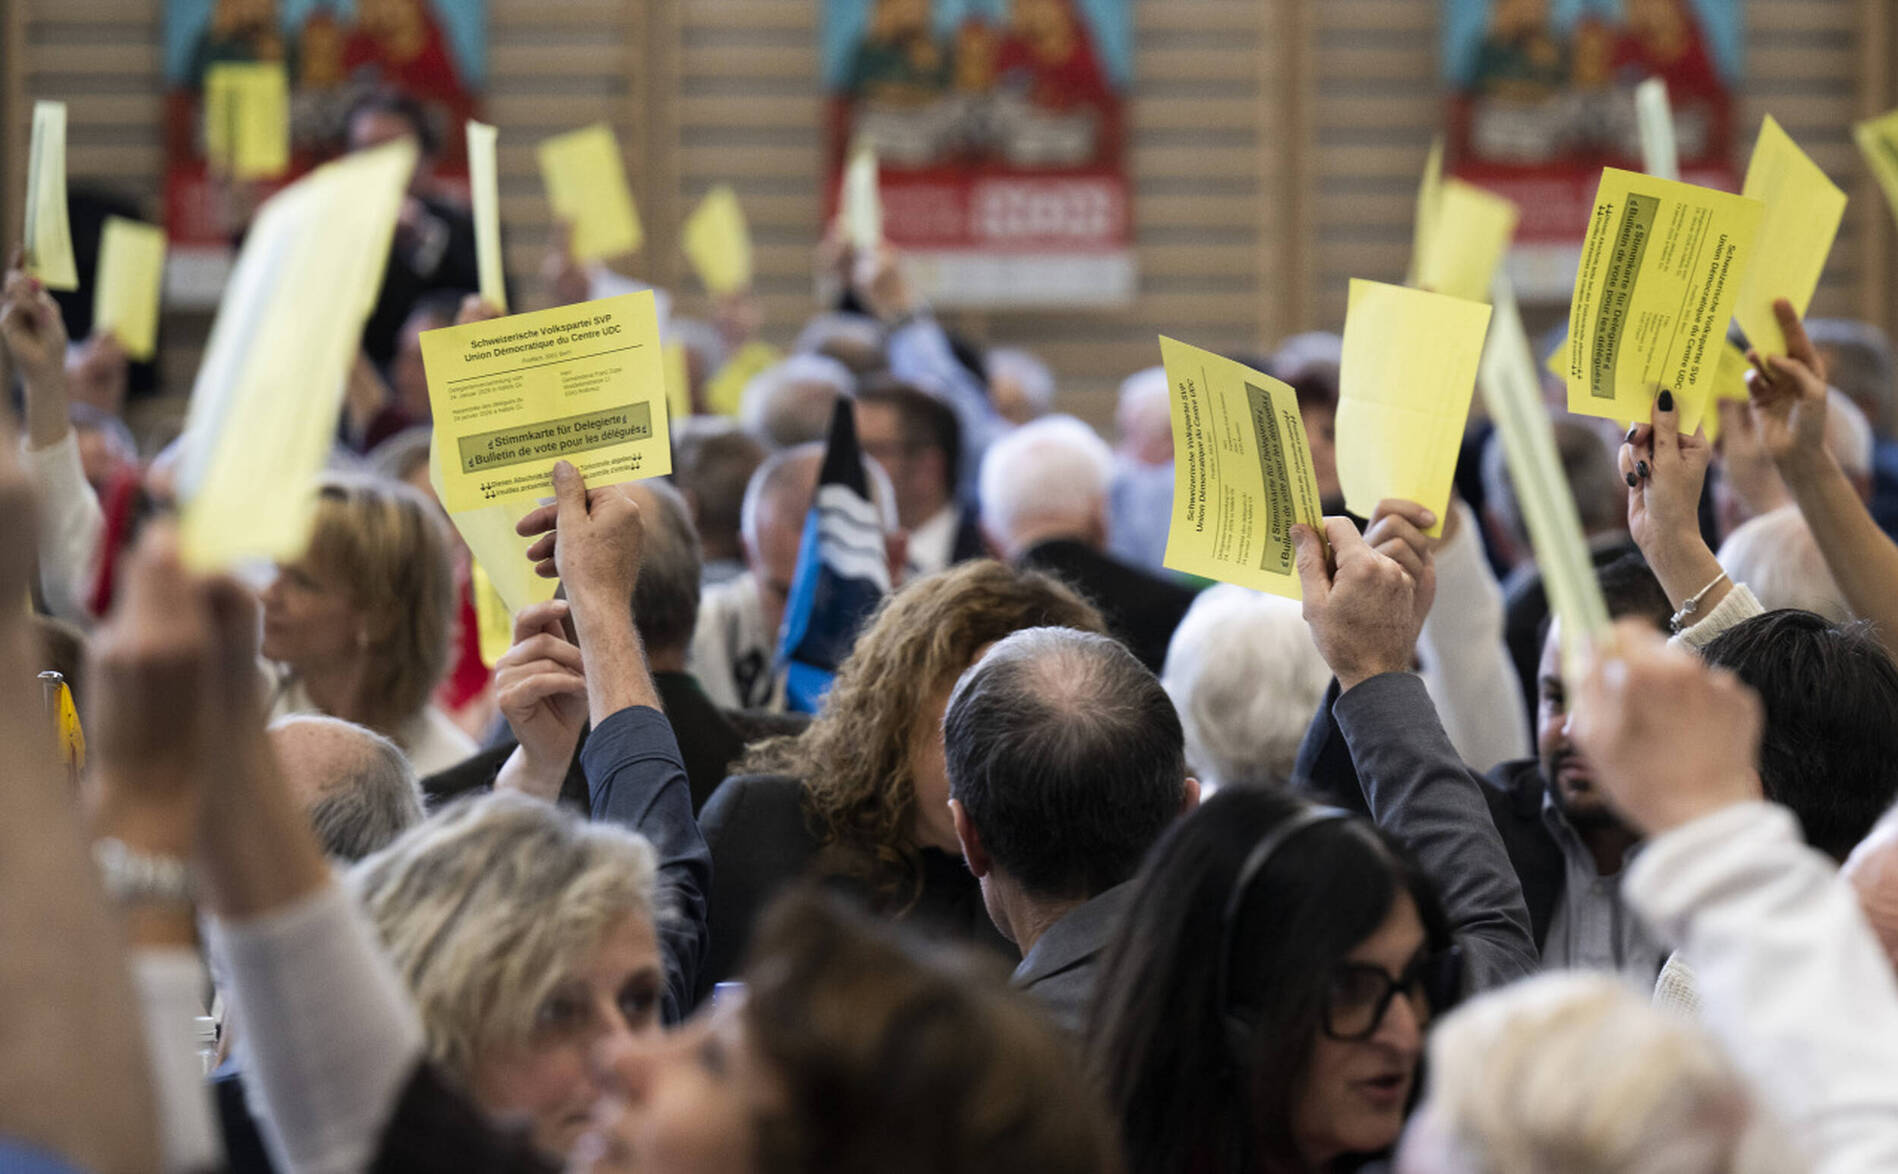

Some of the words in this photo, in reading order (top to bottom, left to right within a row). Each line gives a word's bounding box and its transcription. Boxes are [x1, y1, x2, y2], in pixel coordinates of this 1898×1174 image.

[1620, 207, 1638, 247] Bulletin
[1616, 249, 1626, 262] de
[1621, 231, 1644, 289] Stimmkarte
[1713, 234, 1728, 260] Union
[1609, 265, 1621, 291] vote
[1695, 262, 1719, 323] Démocratique
[1709, 244, 1736, 312] Schweizerische
[1603, 289, 1614, 314] pour
[1616, 292, 1627, 306] für
[471, 330, 539, 349] Schweizerische
[540, 320, 592, 335] Volkspartei
[593, 314, 611, 325] SVP
[1599, 317, 1609, 332] les
[1605, 309, 1622, 363] Delegierte
[1690, 325, 1700, 337] du
[464, 352, 492, 362] Union
[494, 340, 554, 357] Démocratique
[556, 335, 569, 345] du
[571, 331, 600, 342] Centre
[602, 325, 621, 336] UDC
[1681, 338, 1695, 368] Centre
[1693, 315, 1715, 364] Volkspartei
[1594, 335, 1608, 384] délégués
[1187, 378, 1196, 397] UDC
[1674, 370, 1686, 389] UDC
[1689, 366, 1699, 385] SVP
[1179, 383, 1188, 400] SVP
[1183, 402, 1194, 448] Volkspartei
[1192, 399, 1200, 427] Centre
[1262, 401, 1277, 441] délégués
[475, 450, 516, 464] Bulletin
[518, 446, 531, 456] de
[534, 443, 557, 453] vote
[559, 438, 583, 451] pour
[585, 435, 599, 444] les
[601, 425, 642, 440] délégués
[495, 426, 559, 447] Stimmkarte
[556, 425, 571, 435] für
[574, 416, 621, 432] Delegierte
[1196, 429, 1202, 439] du
[1257, 412, 1272, 461] Delegierte
[1272, 443, 1280, 457] les
[1198, 441, 1206, 502] Démocratique
[1265, 463, 1274, 477] für
[1275, 458, 1286, 482] pour
[1187, 451, 1196, 521] Schweizerische
[1280, 483, 1290, 504] vote
[1196, 504, 1205, 532] Union
[1269, 479, 1281, 535] Stimmkarte
[1282, 505, 1291, 517] de
[1281, 520, 1291, 560] Bulletin
